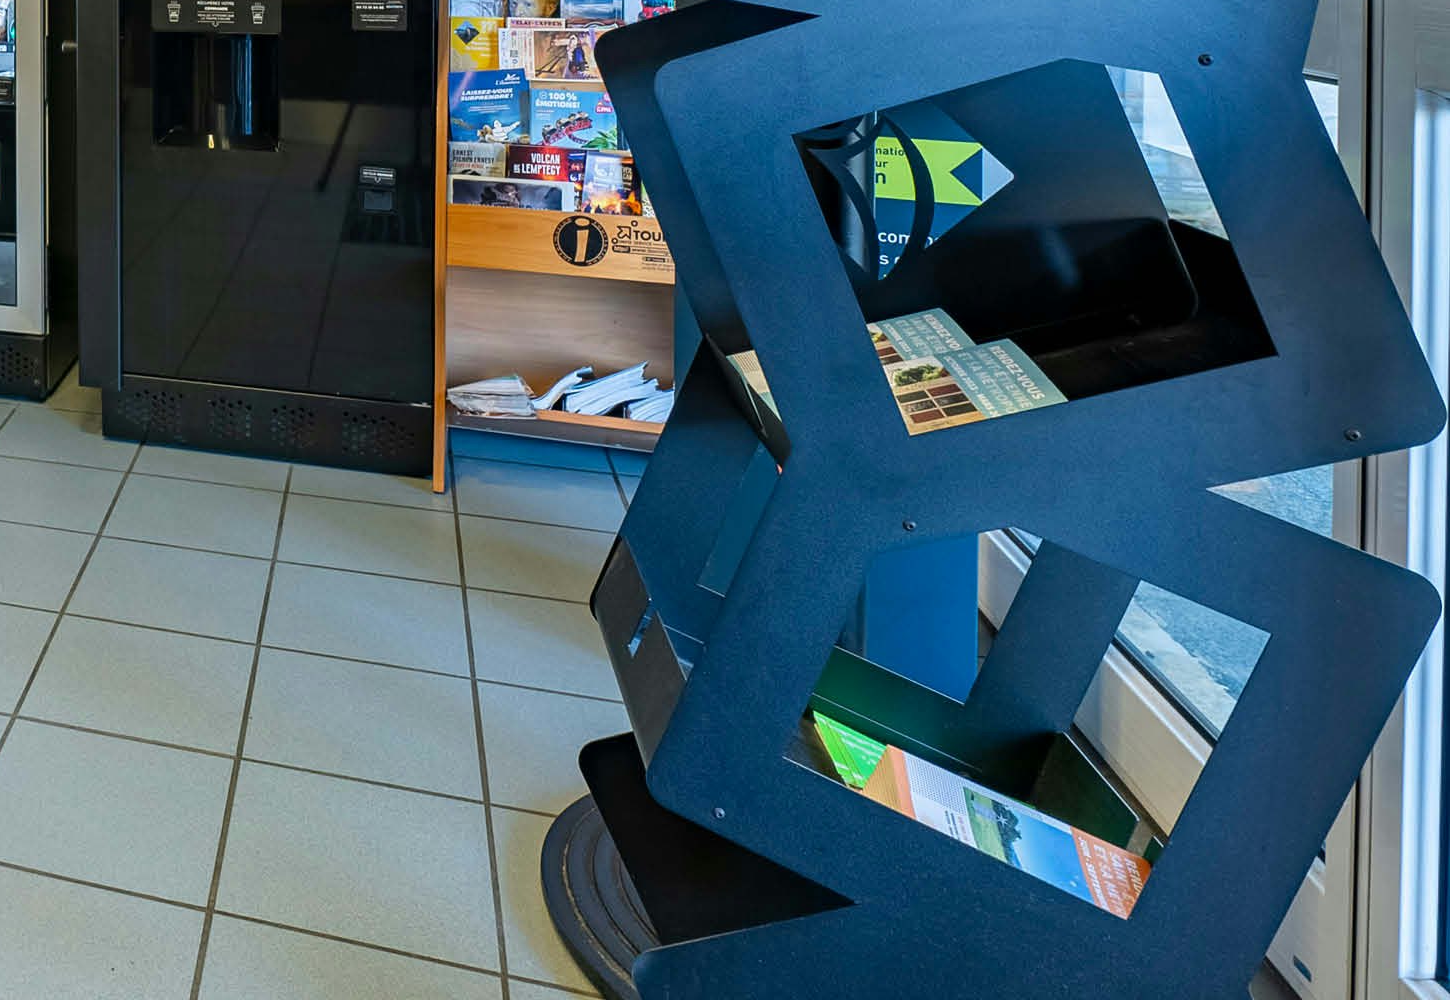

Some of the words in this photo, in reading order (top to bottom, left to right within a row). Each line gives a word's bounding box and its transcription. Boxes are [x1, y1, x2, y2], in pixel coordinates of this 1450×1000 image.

[461, 87, 514, 96] LAISSEZ-VOUS
[530, 152, 561, 164] VOLCAN
[521, 163, 561, 176] LEMPTEGY
[633, 230, 662, 242] TOU
[921, 313, 964, 351] RENDEZ-VO
